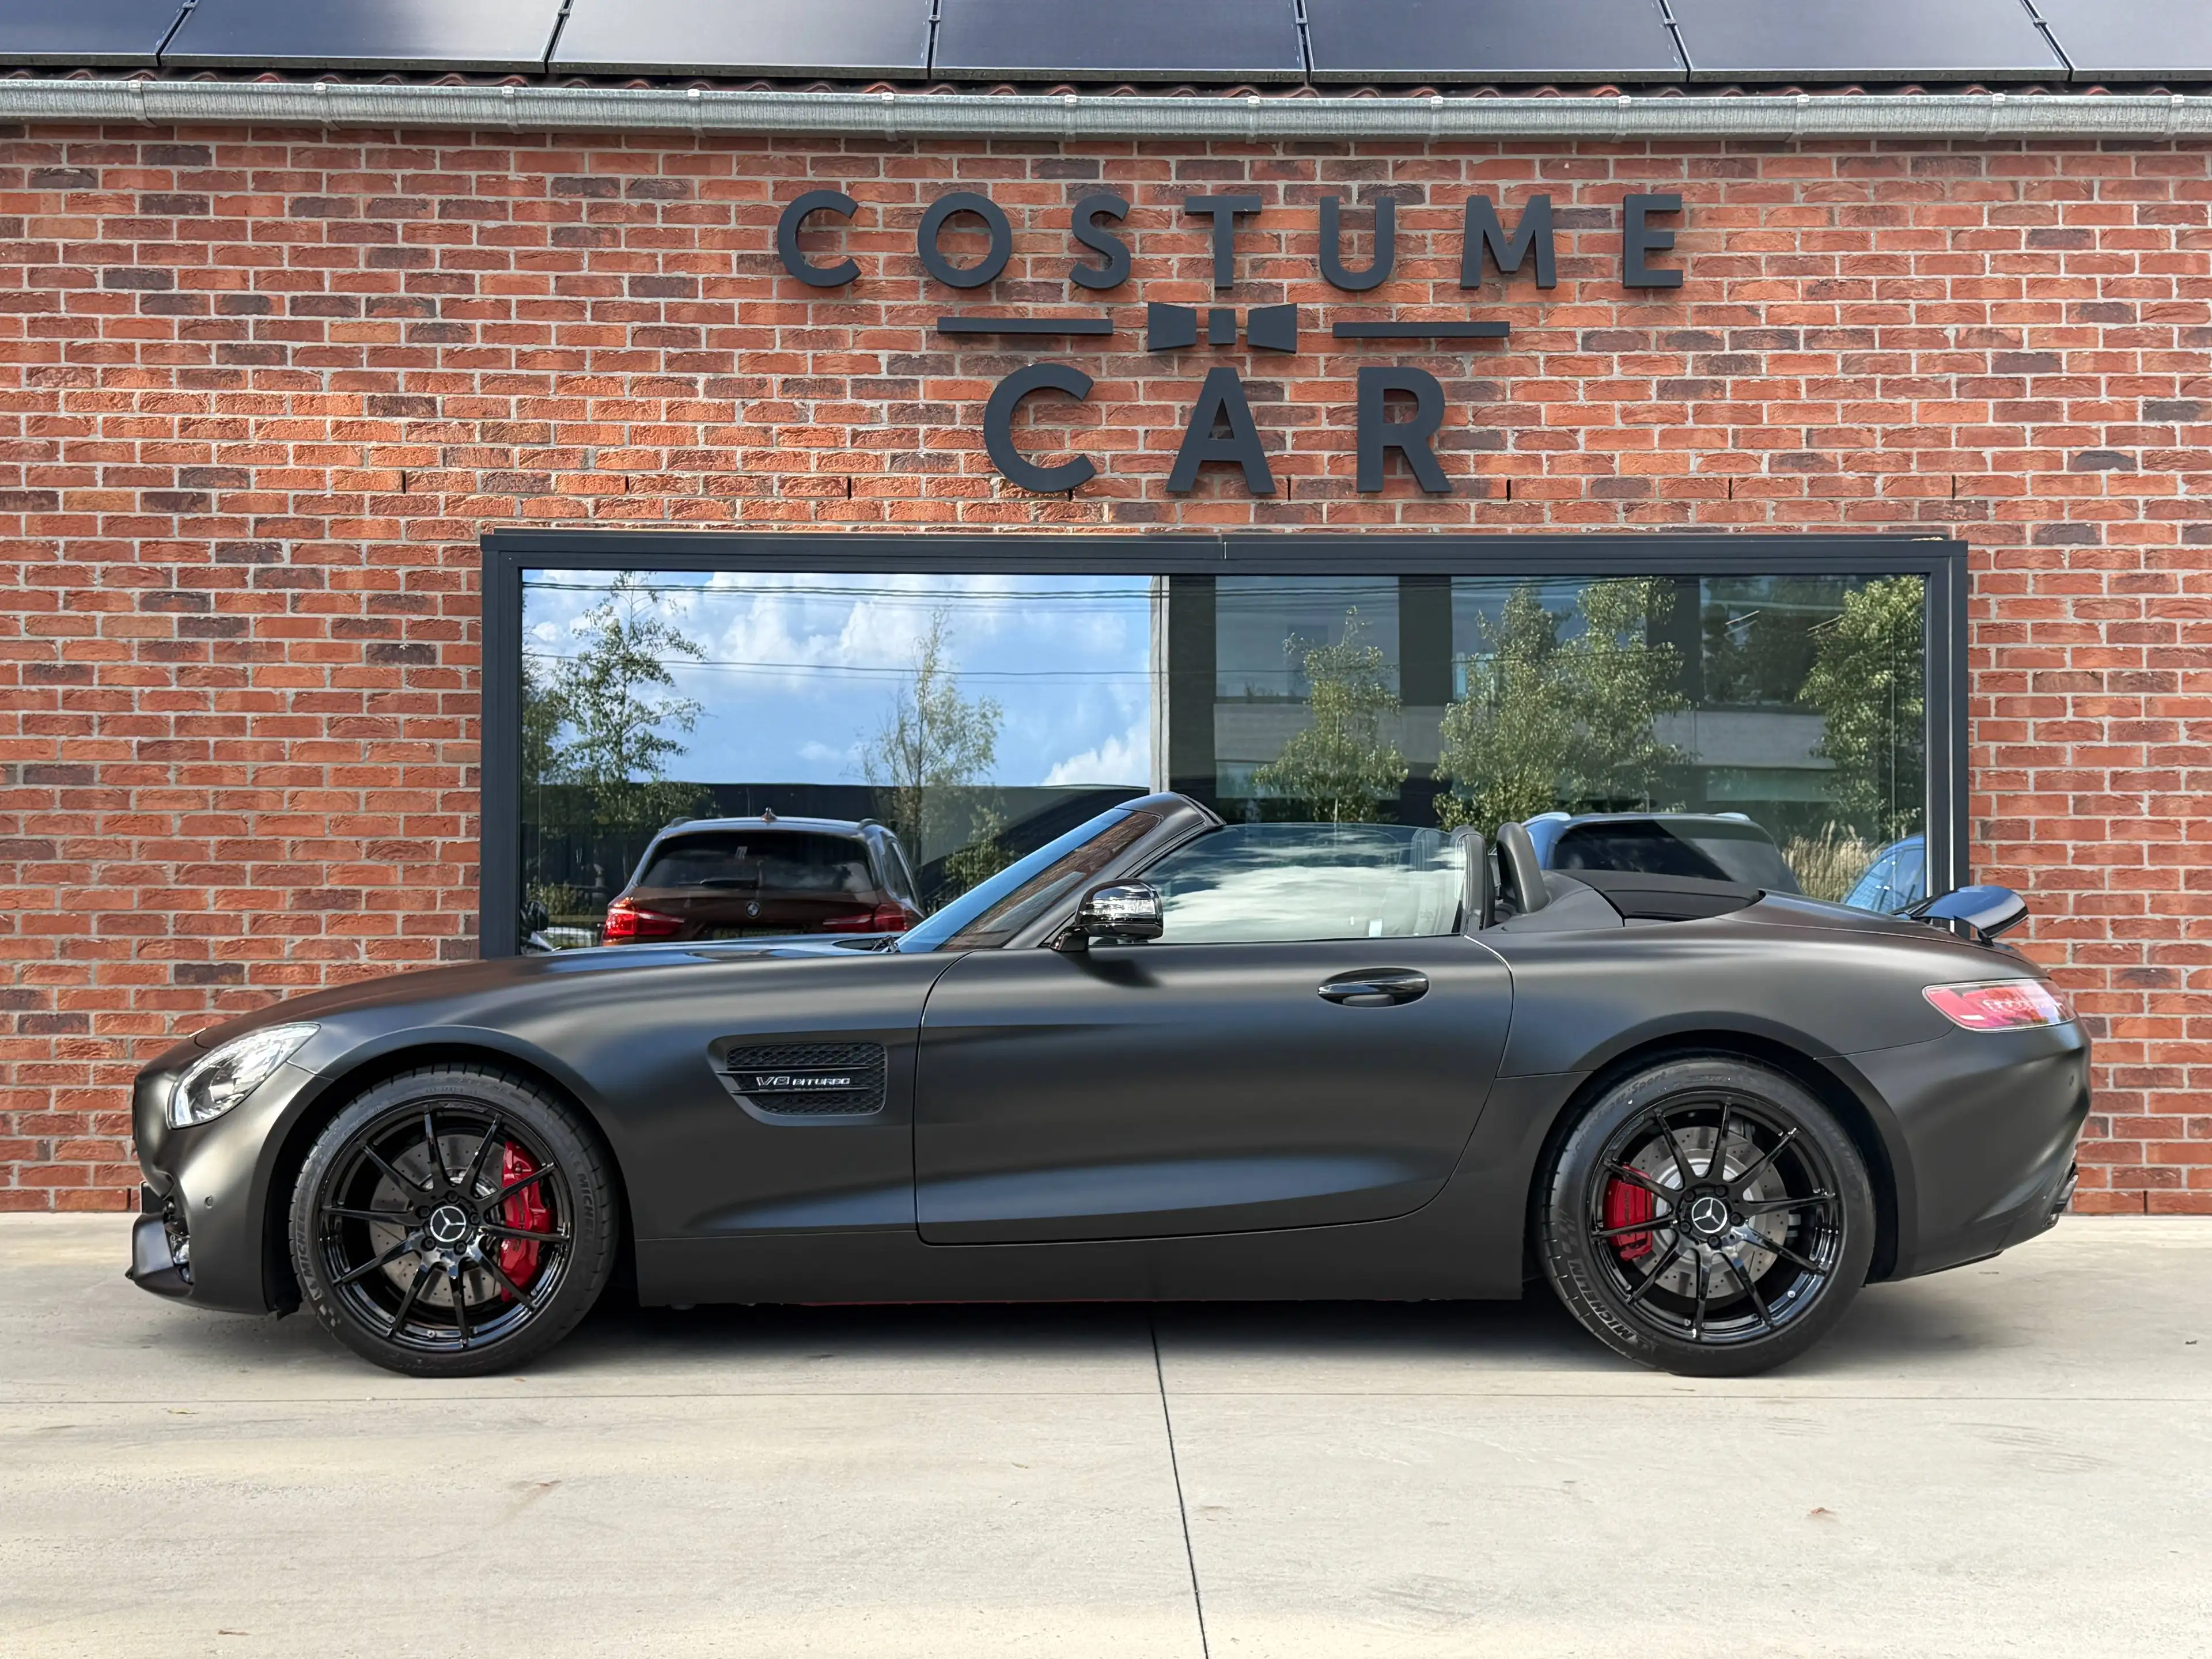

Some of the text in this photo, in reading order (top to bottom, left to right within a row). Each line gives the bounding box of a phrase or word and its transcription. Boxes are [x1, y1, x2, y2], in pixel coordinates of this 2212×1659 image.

[777, 191, 1683, 290] COSTUME
[983, 363, 1452, 494] CAR
[756, 1076, 790, 1086] V8
[1568, 1261, 1635, 1340] MICHELIN
